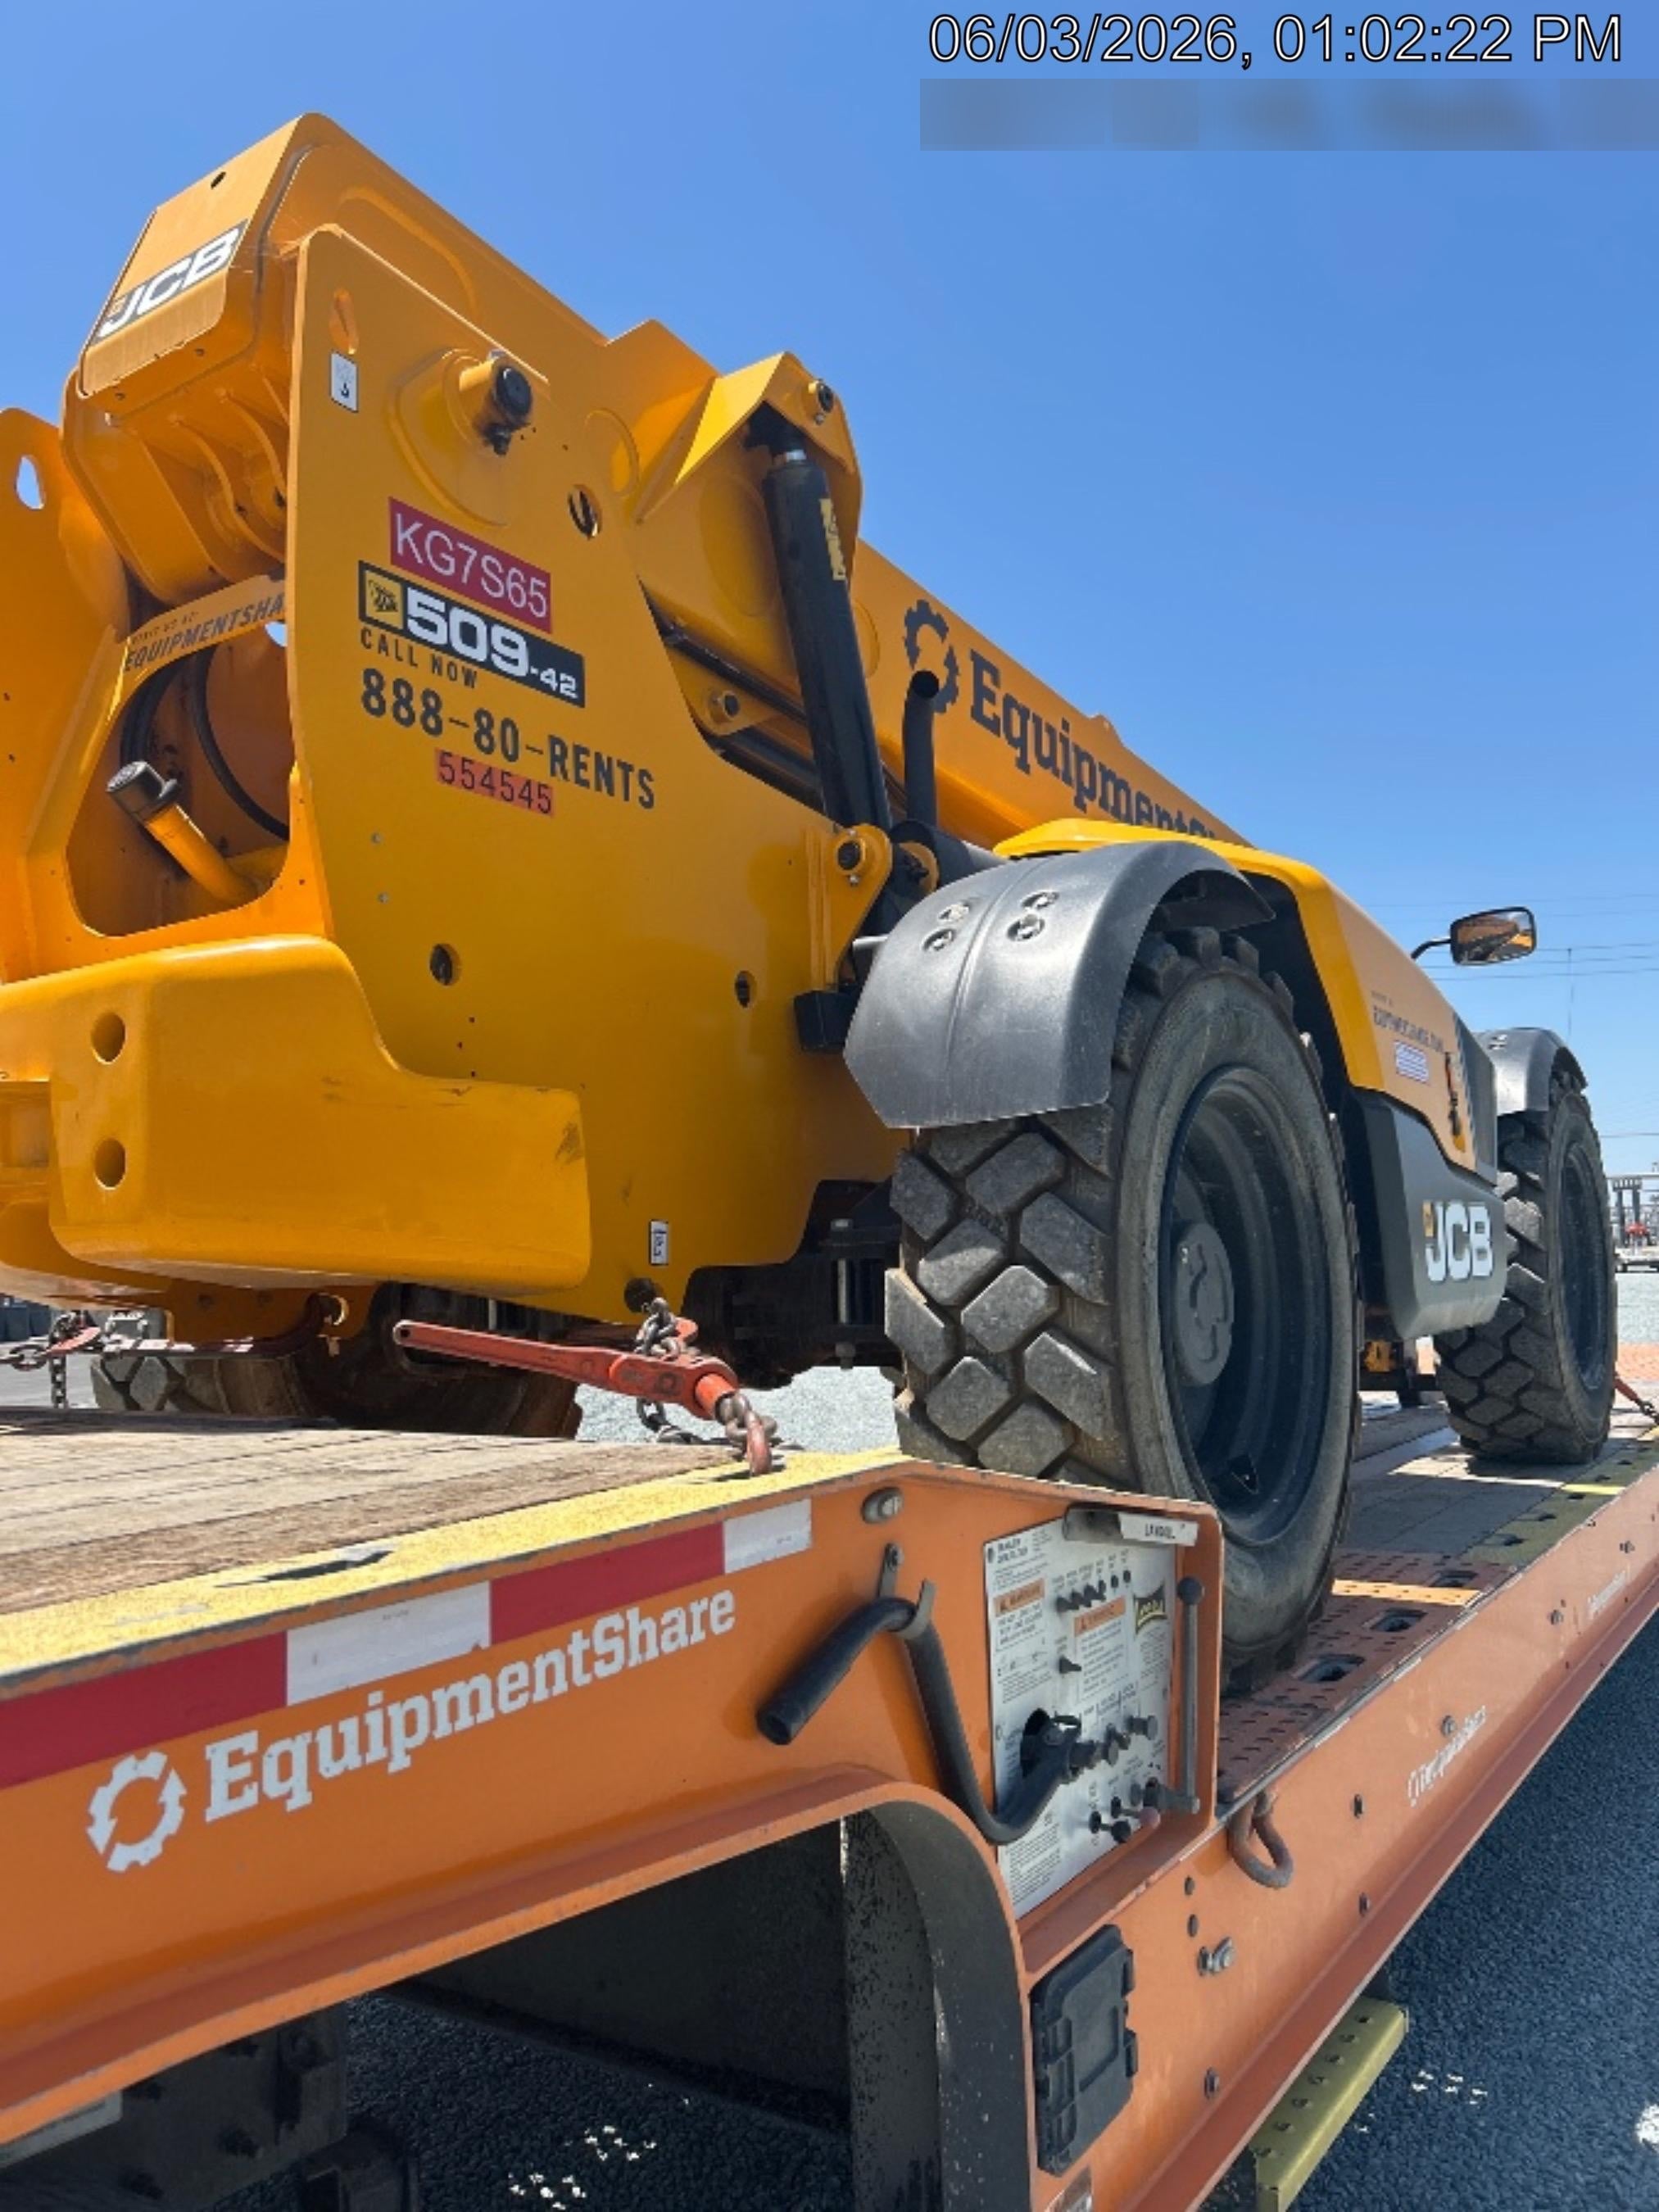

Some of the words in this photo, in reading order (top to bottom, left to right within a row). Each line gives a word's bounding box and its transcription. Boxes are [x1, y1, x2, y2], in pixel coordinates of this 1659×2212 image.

[97, 228, 240, 338] JCB
[395, 513, 548, 619] KG7S65
[125, 592, 285, 672] EQUIPMENTSHA
[360, 628, 418, 669] CALL
[431, 654, 478, 689] NOW
[406, 587, 578, 699] 509-42
[360, 668, 655, 809] 888-80-RENTS
[438, 750, 552, 814] 554545
[1425, 1201, 1494, 1281] JCB
[204, 1589, 736, 1824] EquipmentShare
